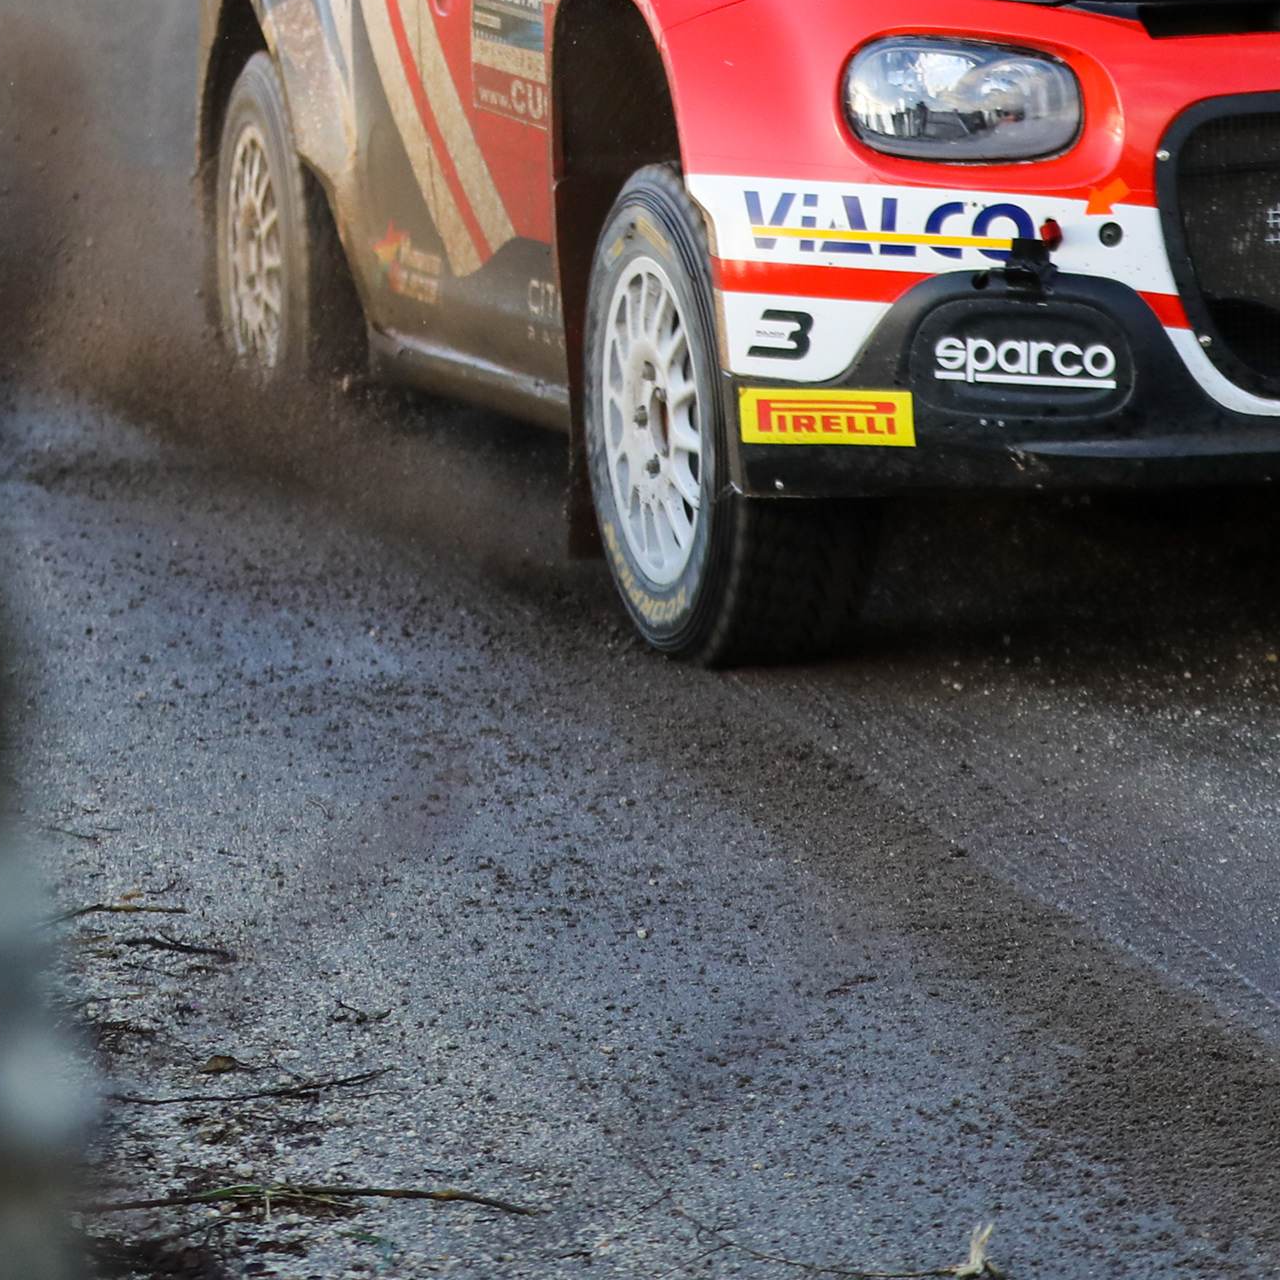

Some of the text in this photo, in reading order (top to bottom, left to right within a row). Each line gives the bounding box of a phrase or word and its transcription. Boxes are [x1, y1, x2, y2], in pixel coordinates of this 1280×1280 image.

[478, 79, 548, 120] www.CU
[934, 336, 1117, 387] sparco
[756, 398, 897, 437] PIRELLI
